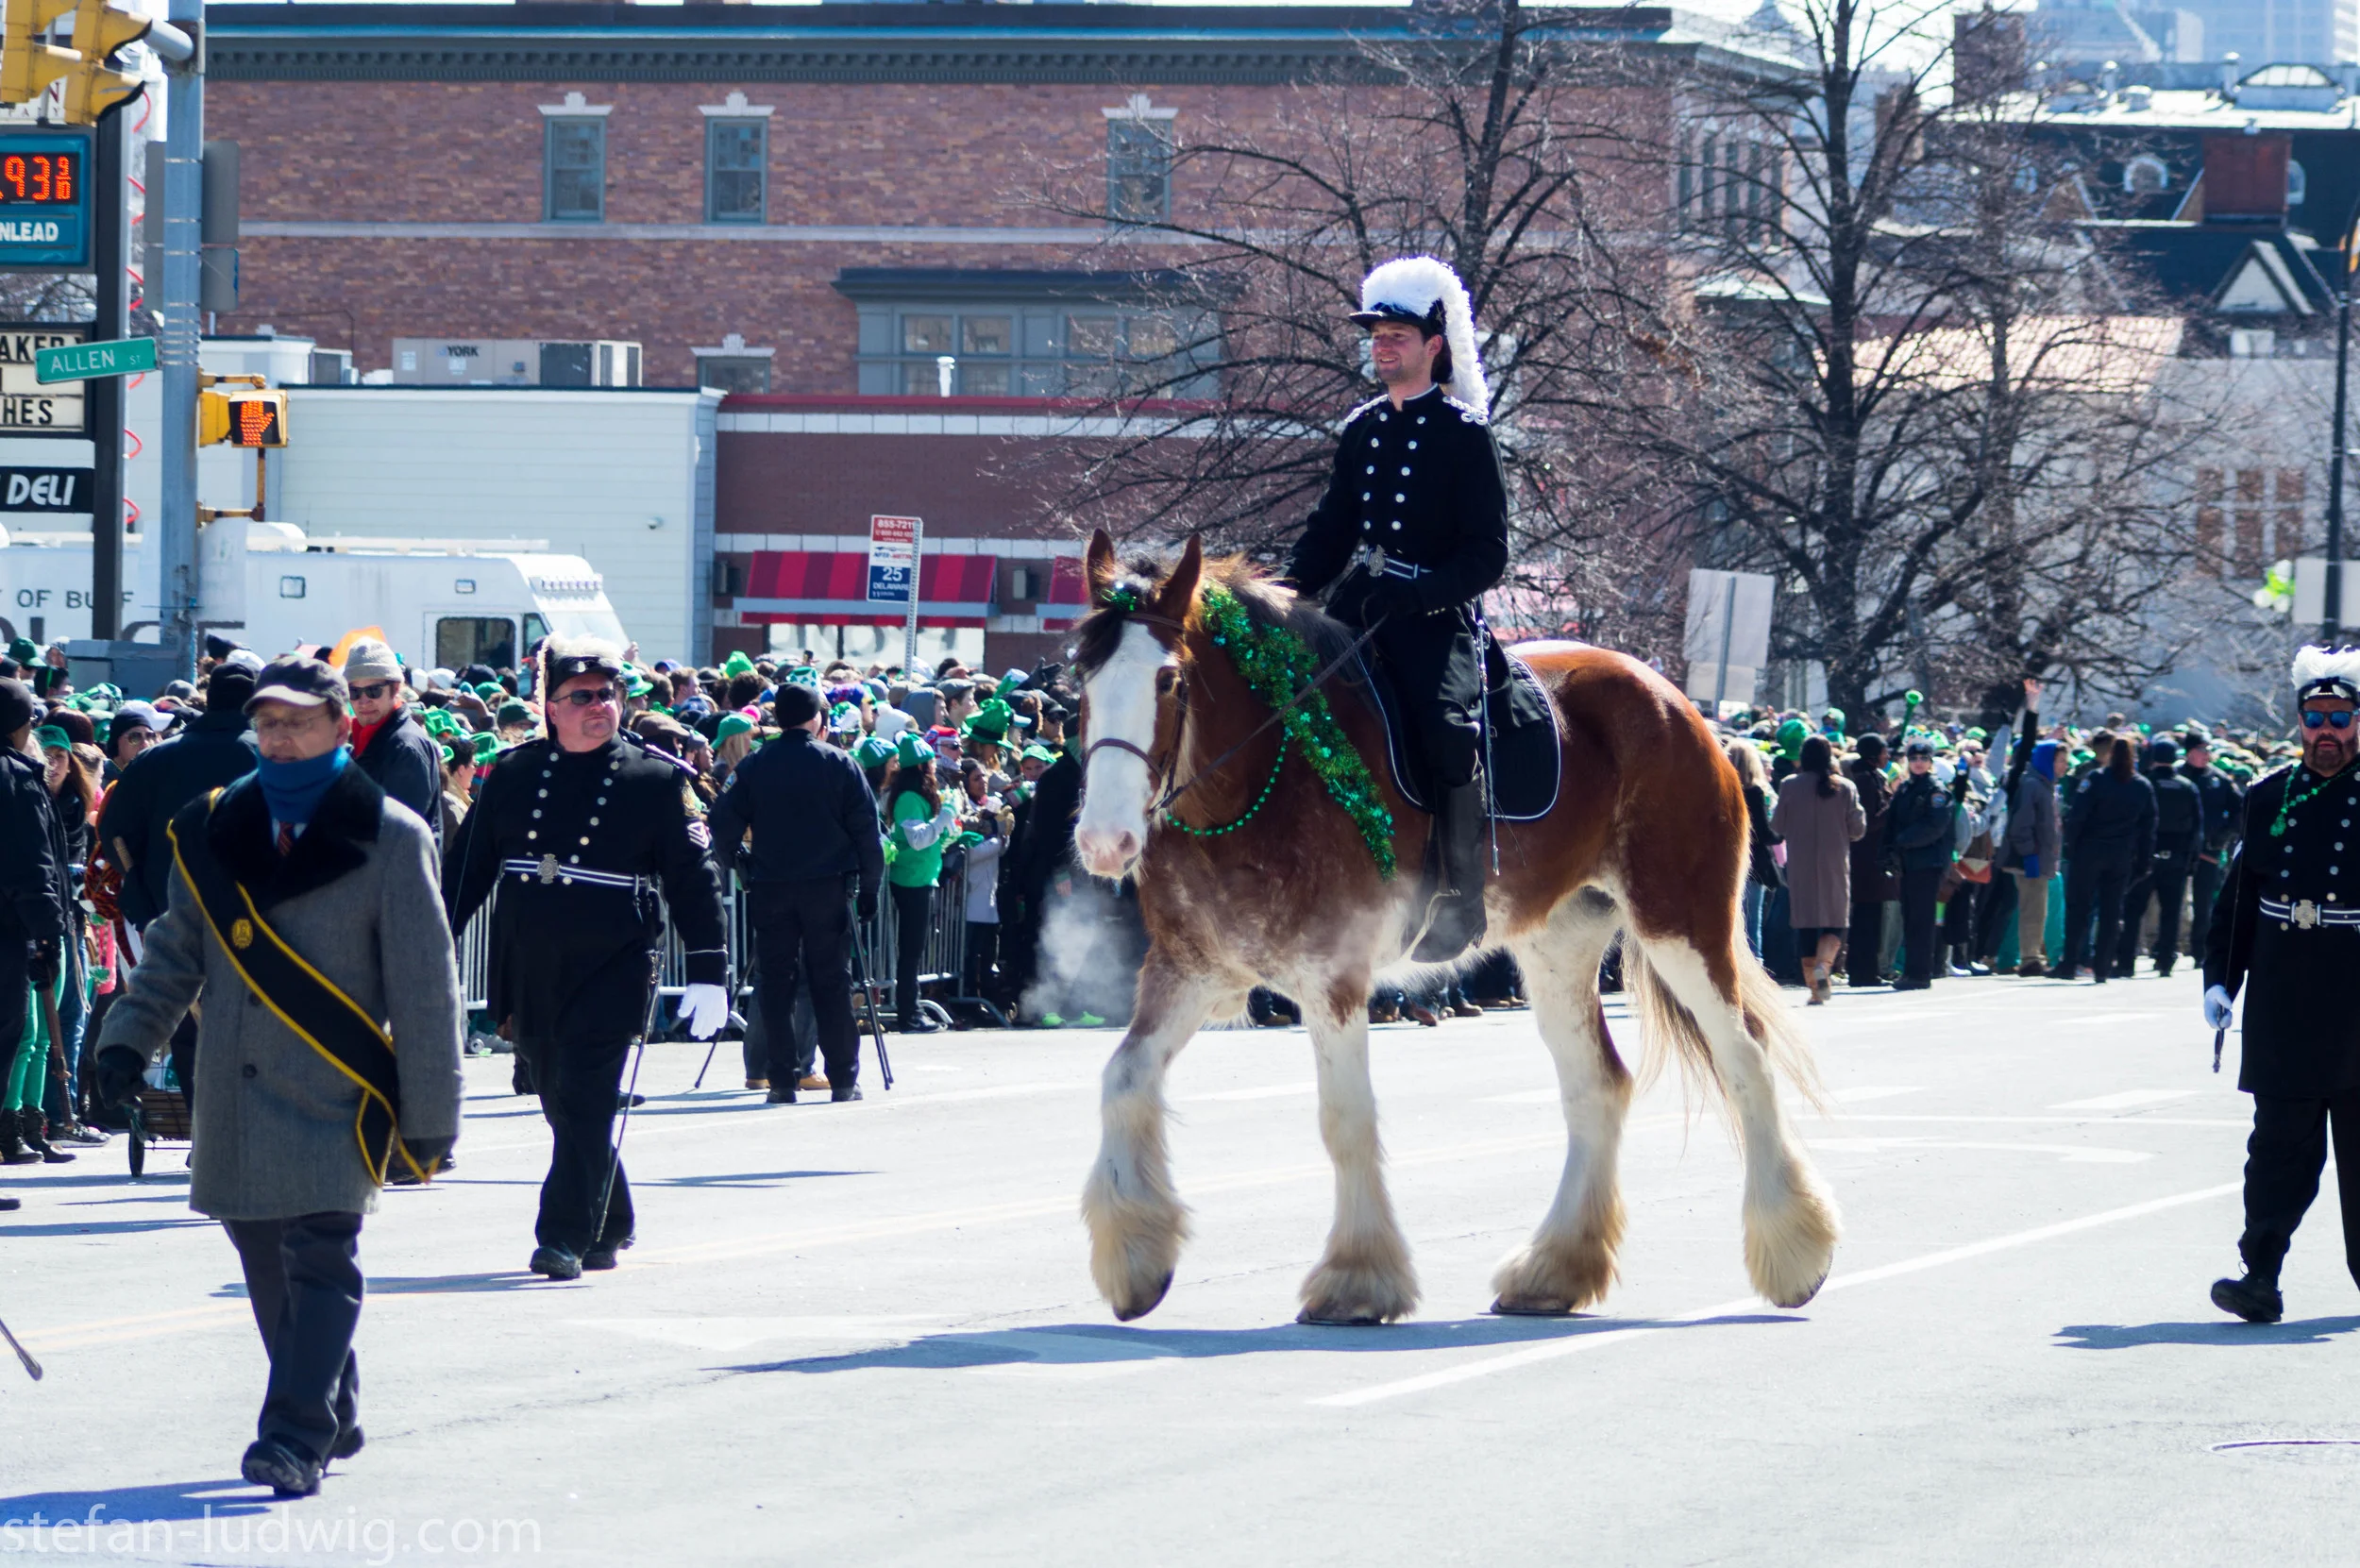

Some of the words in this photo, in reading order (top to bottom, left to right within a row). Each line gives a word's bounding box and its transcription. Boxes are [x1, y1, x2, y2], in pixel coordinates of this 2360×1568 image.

[50, 348, 115, 374] ALLEN
[128, 354, 142, 365] ST
[447, 345, 480, 358] YORK
[2, 398, 53, 425] HES
[6, 474, 76, 506] DELI
[882, 566, 903, 582] 25
[16, 588, 53, 609] OF
